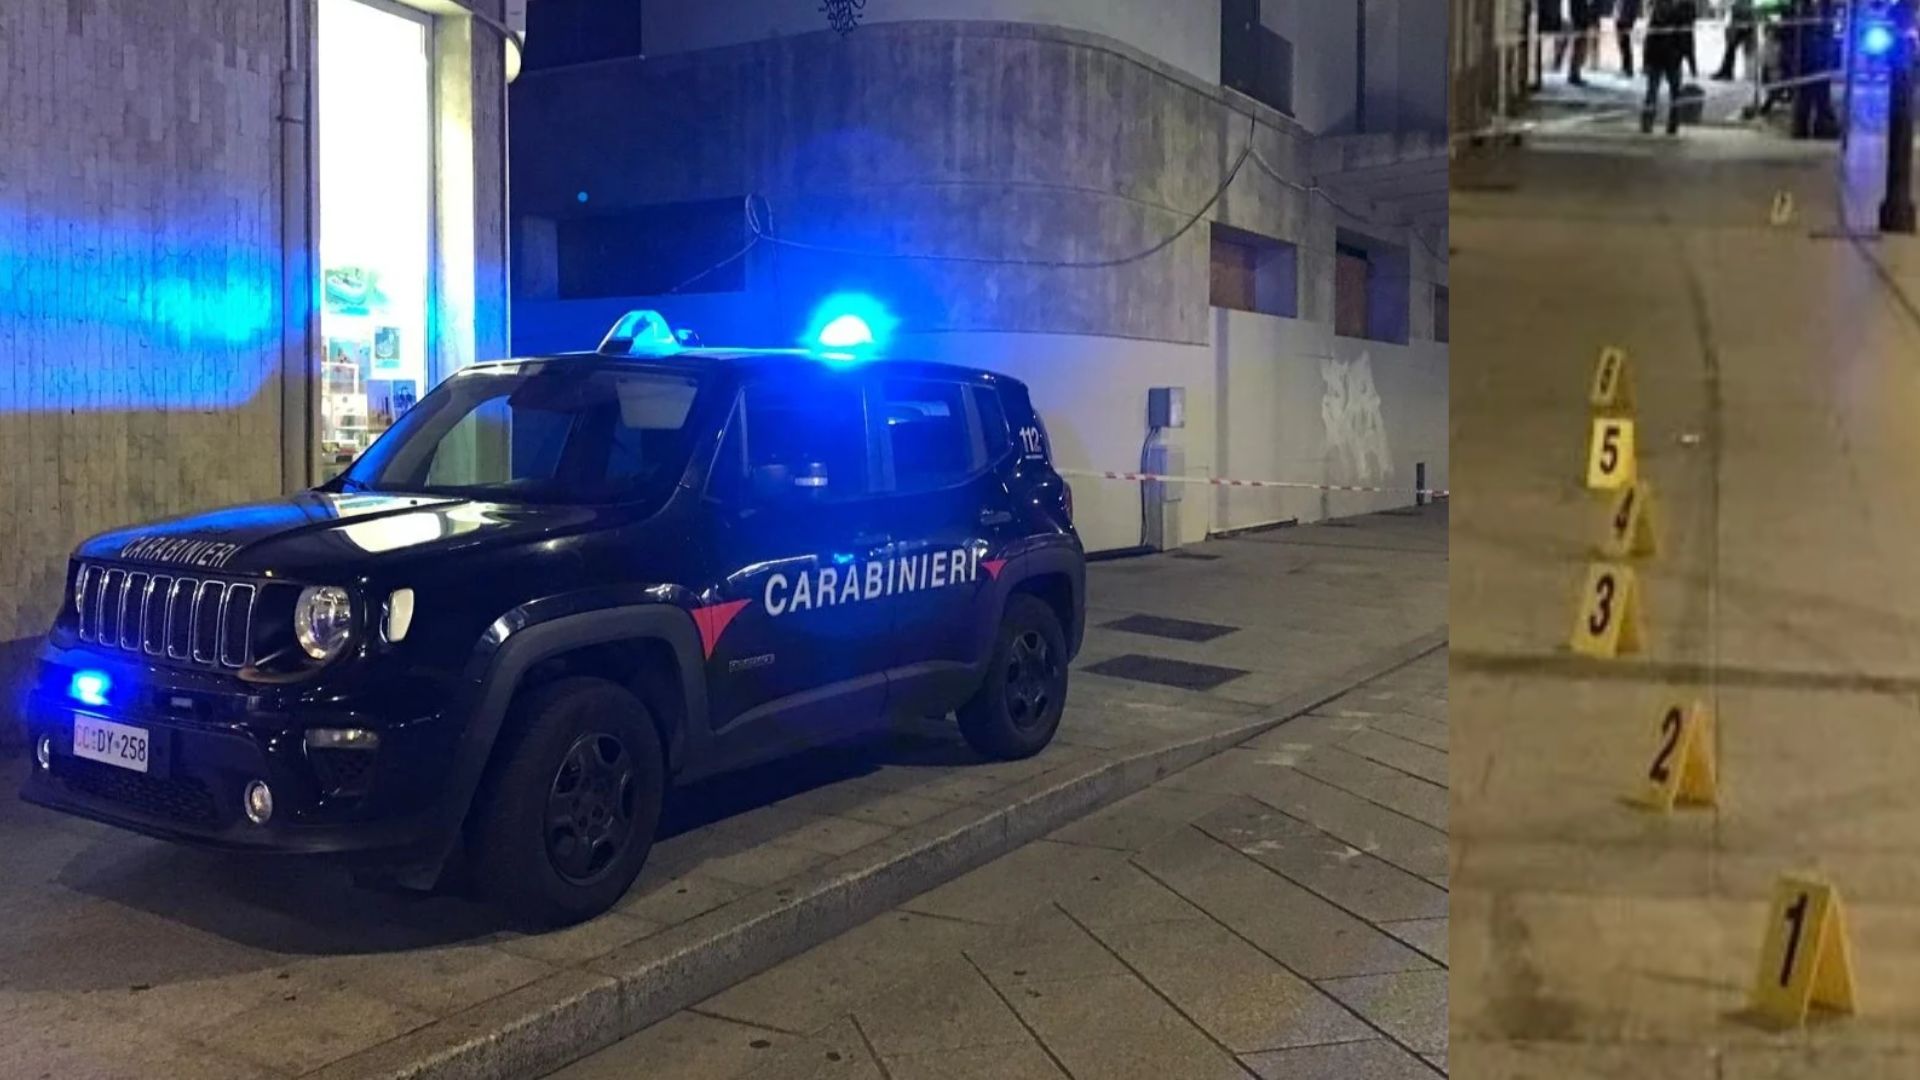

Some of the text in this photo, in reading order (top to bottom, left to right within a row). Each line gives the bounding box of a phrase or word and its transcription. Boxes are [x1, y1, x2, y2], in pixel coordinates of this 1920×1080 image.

[1019, 426, 1042, 452] 112
[1600, 425, 1620, 474] 5
[121, 536, 243, 568] CARABINIERI
[764, 547, 978, 617] CARABINIERI
[1590, 572, 1615, 636] 3
[121, 734, 147, 762] 258
[1649, 706, 1682, 784] 2
[1780, 892, 1808, 988] 1
